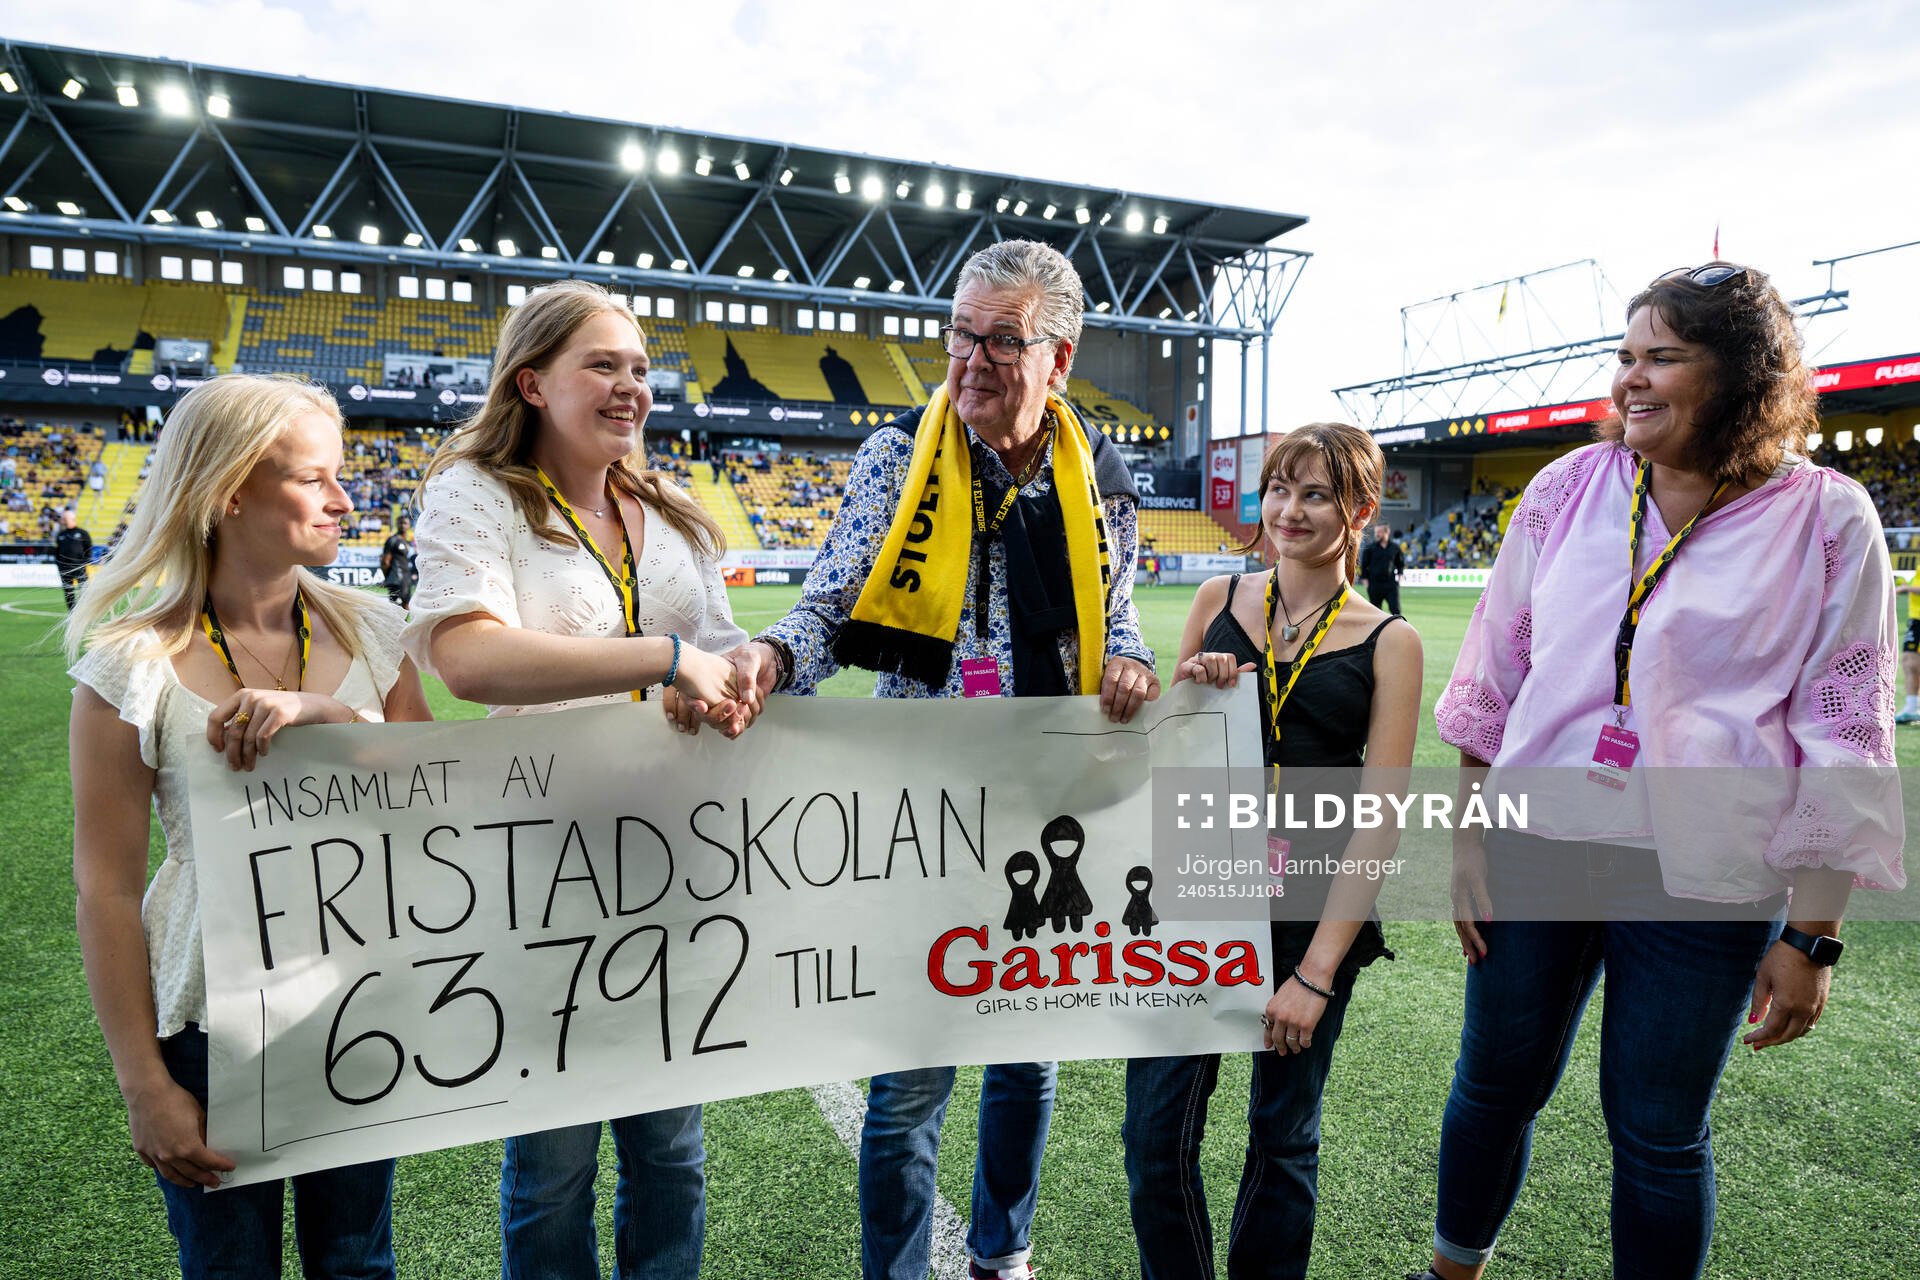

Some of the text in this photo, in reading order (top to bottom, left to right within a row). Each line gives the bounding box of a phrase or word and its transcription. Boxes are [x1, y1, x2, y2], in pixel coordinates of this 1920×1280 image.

[1603, 757, 1620, 767] 2024
[1610, 738, 1636, 749] PASSAGE
[245, 753, 555, 830] INSAMLAT AV
[249, 786, 986, 971] FRISTADSKOLAN
[927, 921, 1265, 997] Garissa
[325, 914, 877, 1106] 63.792 TILL
[976, 992, 1209, 1015] GIRLS HOME IN KENYA
